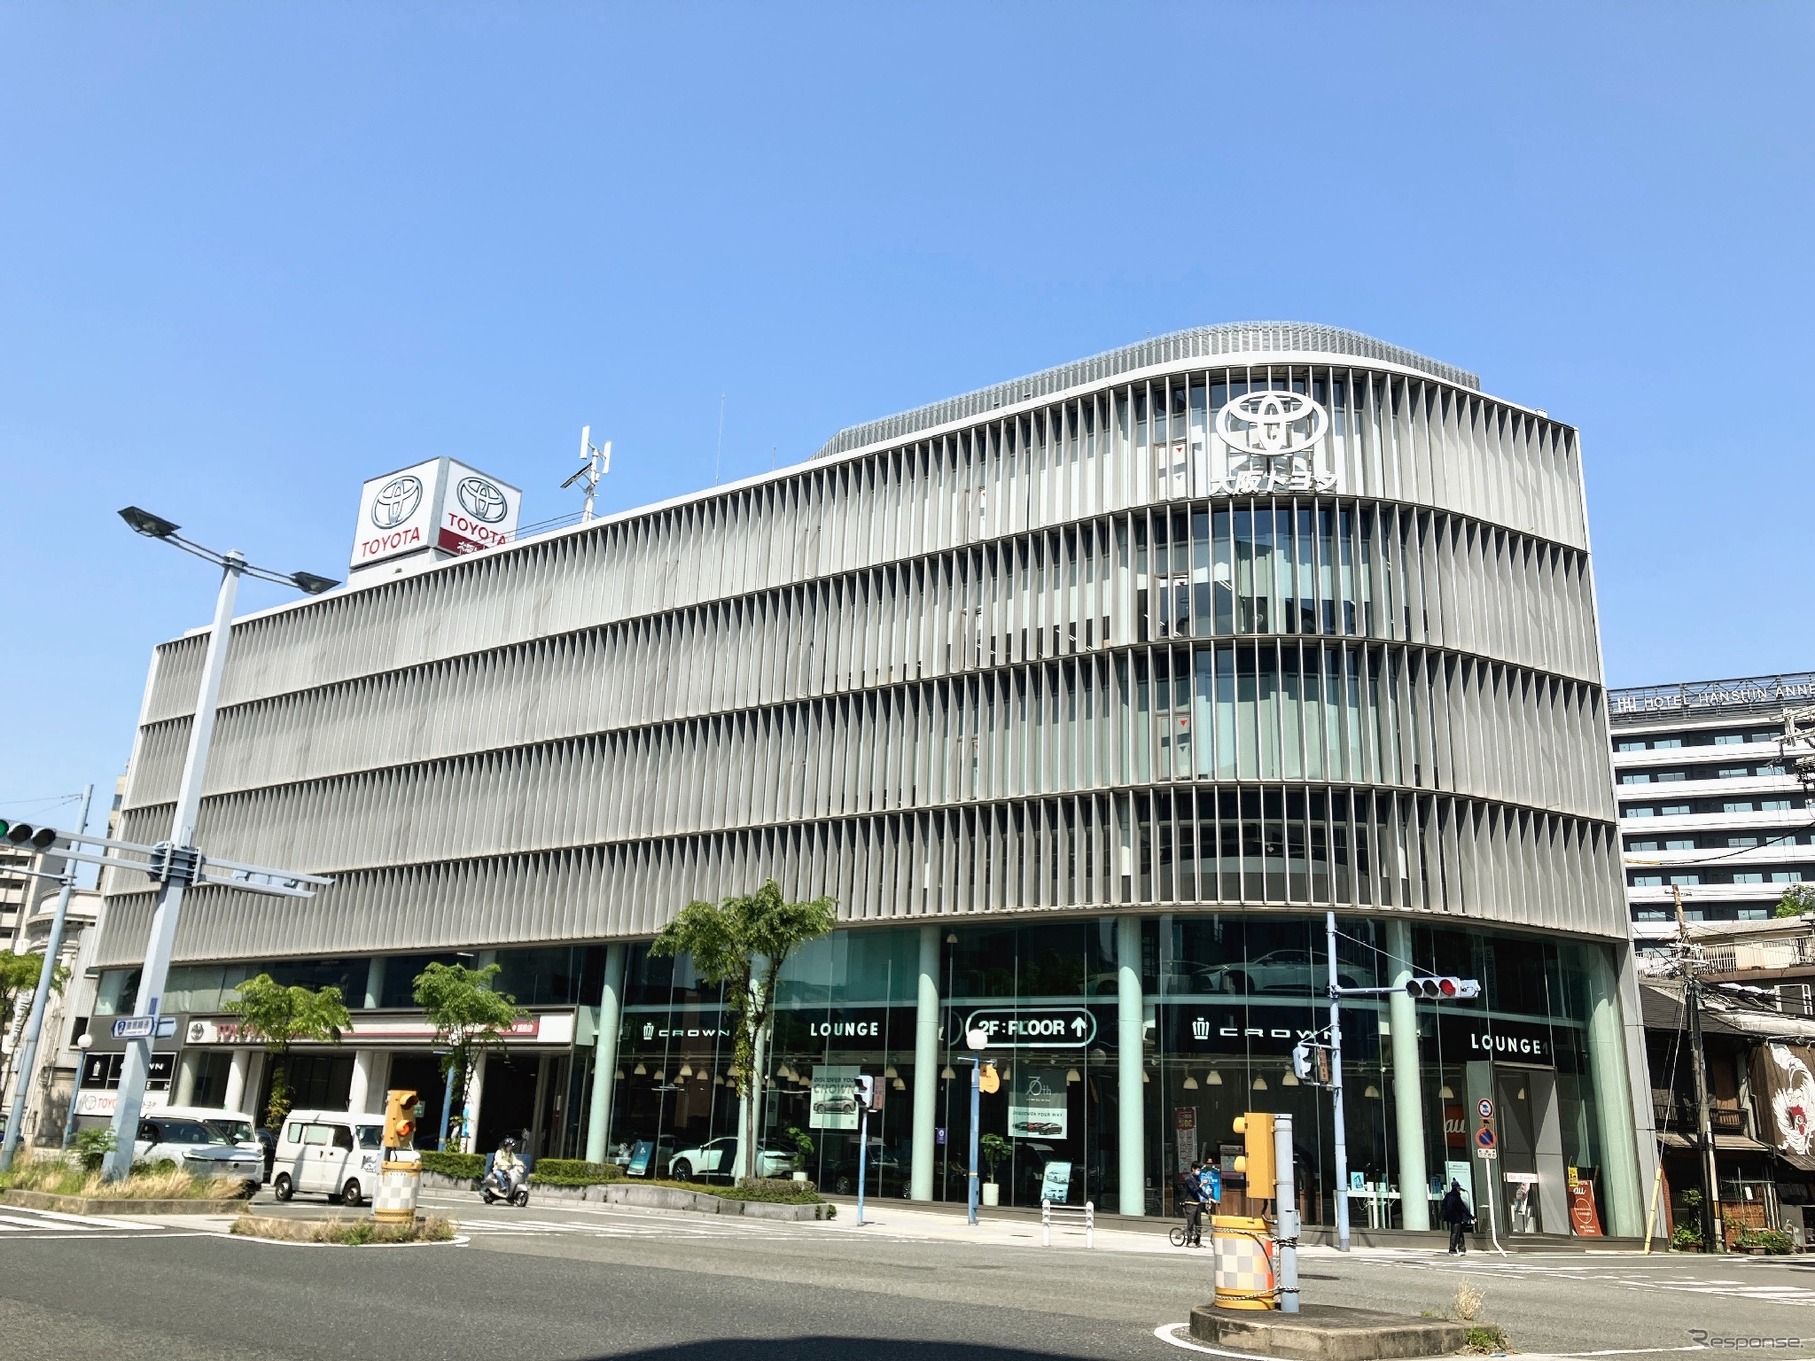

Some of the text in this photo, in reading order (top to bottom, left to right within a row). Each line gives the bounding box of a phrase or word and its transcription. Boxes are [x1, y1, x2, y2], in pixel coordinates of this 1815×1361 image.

[1209, 470, 1339, 496] 大阪トヨタ
[448, 512, 506, 546] TOYOTA
[361, 526, 421, 558] TOYOTA
[1644, 694, 1691, 709] HOTEL
[1698, 688, 1767, 704] HANSHIN
[658, 1028, 730, 1038] CROWN
[810, 1021, 878, 1037] LOUNGE
[1219, 1027, 1343, 1040] CROWN
[1471, 1033, 1541, 1055] LOUNGE
[813, 1083, 856, 1094] CROWN
[1444, 1118, 1466, 1134] au
[1573, 1186, 1587, 1195] au
